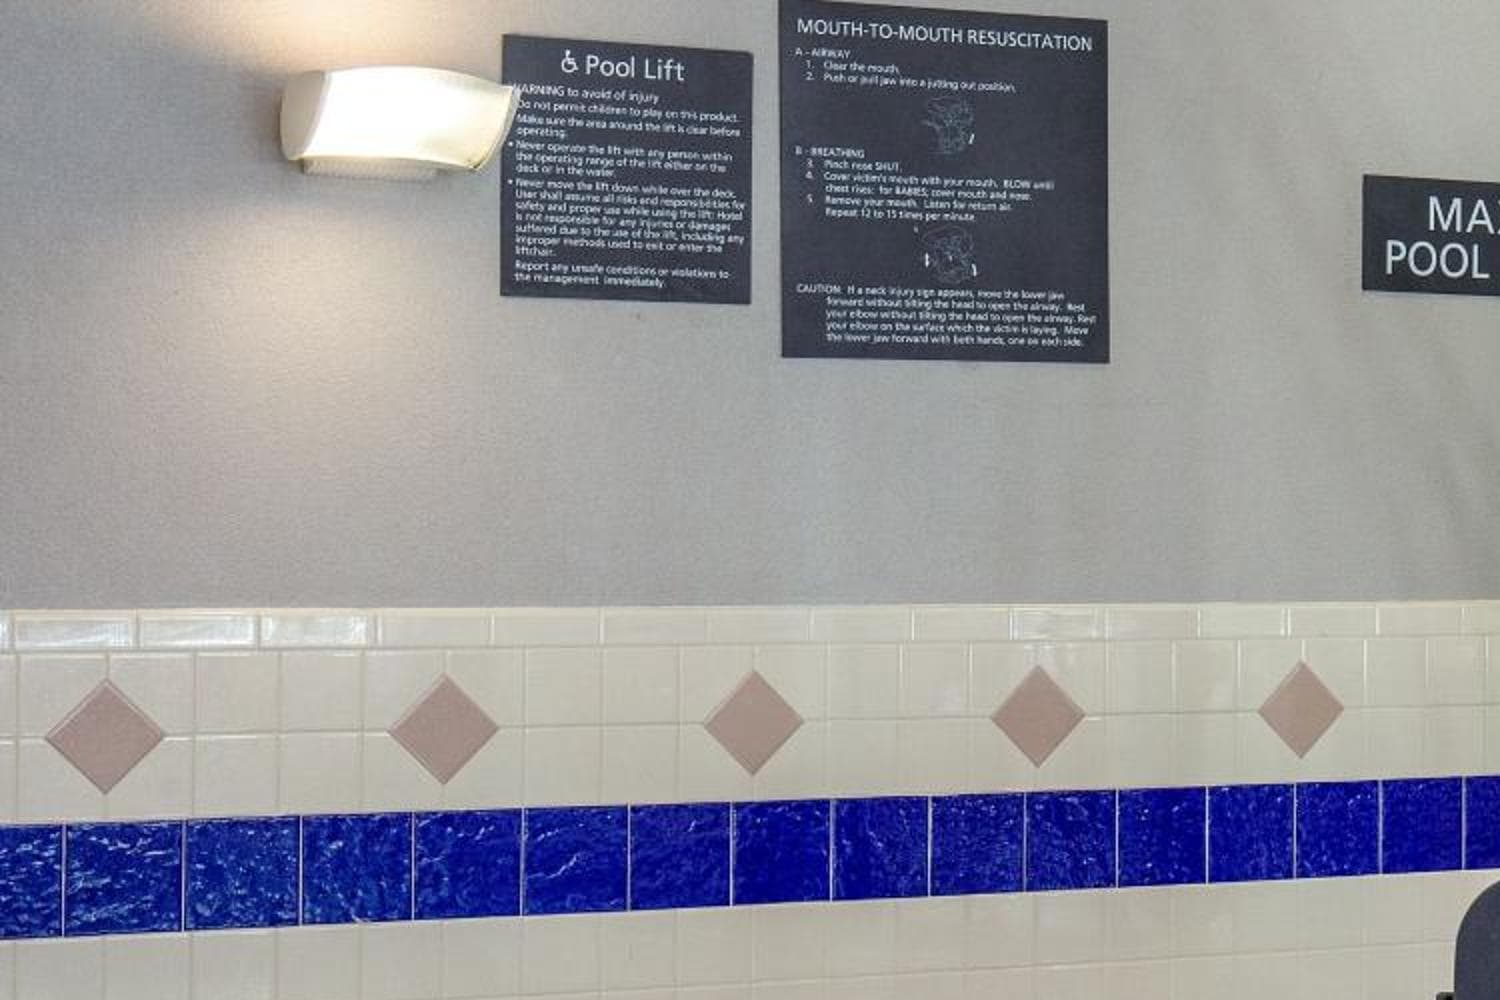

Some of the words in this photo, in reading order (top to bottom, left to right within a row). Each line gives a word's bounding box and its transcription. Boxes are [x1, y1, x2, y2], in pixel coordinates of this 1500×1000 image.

[797, 18, 963, 43] MOUTH-TO-MOUTH
[967, 29, 1093, 51] RESUSCITATION
[796, 48, 802, 56] A
[811, 48, 850, 58] AIRWAY
[586, 54, 635, 78] Pool
[644, 58, 685, 82] Lift
[823, 61, 847, 71] Clear
[850, 62, 866, 72] the
[824, 72, 846, 82] Push
[860, 74, 878, 85] pull
[879, 75, 897, 86] jaw
[899, 77, 918, 87] into
[927, 79, 958, 90] jutting
[960, 81, 976, 90] out
[512, 83, 565, 97] WARNING
[567, 88, 578, 97] to
[582, 89, 611, 99] avoid
[614, 90, 625, 100] of
[628, 92, 660, 105] injury
[1386, 239, 1490, 279] POOL
